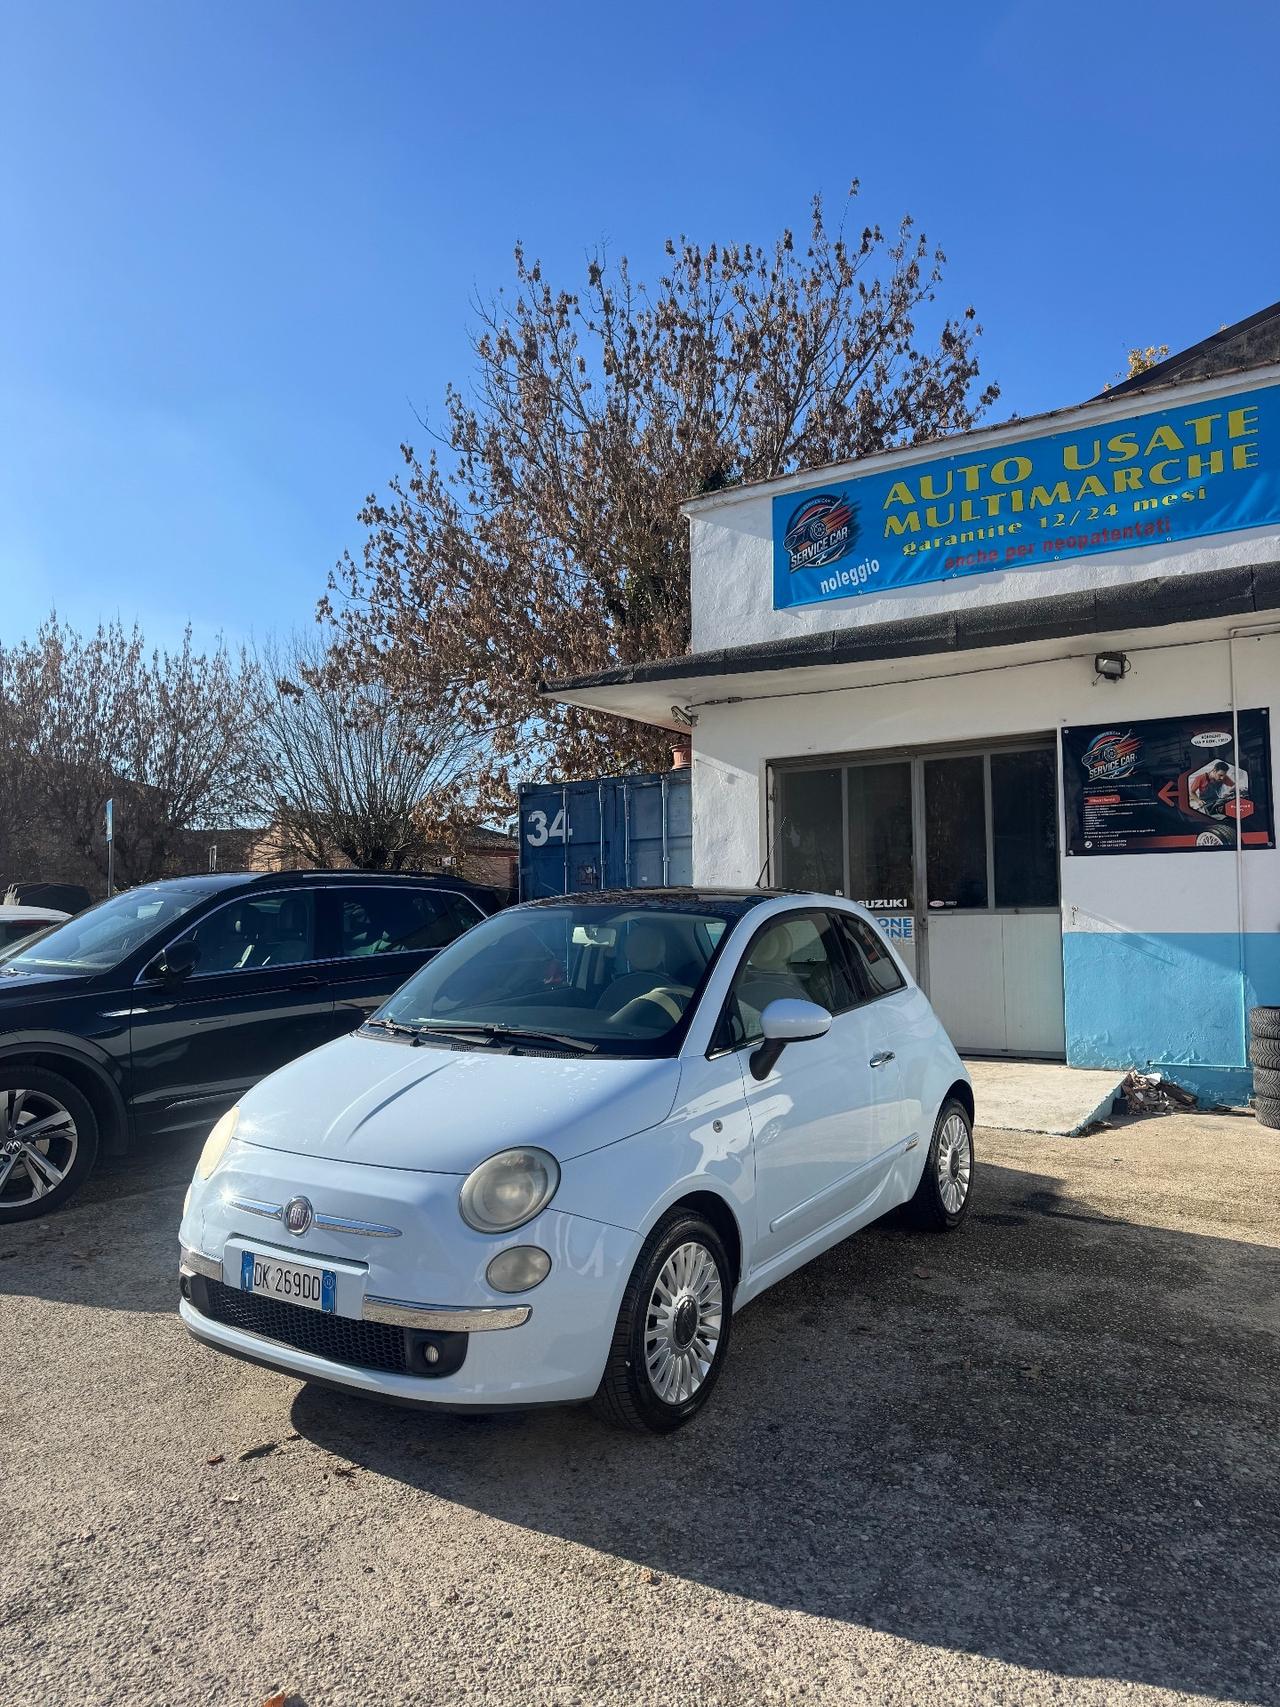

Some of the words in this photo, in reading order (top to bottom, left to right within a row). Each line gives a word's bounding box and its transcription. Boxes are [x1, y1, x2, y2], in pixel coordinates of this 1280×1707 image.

[882, 456, 1033, 510] AUTO
[1063, 406, 1259, 471] USATE
[884, 442, 1259, 538] MULTIMARCHE
[902, 522, 1024, 556] garantite
[1039, 503, 1119, 529] 12/24
[1133, 486, 1207, 512] mesi
[790, 537, 829, 568] SERVICE
[829, 526, 848, 546] CAR
[944, 546, 999, 570] anche
[1005, 543, 1035, 562] per
[1042, 516, 1172, 552] neopatentati
[820, 558, 880, 595] noleggio
[1089, 759, 1120, 779] SERVICE
[1120, 753, 1136, 766] CAR
[526, 809, 574, 847] 34
[289, 1207, 306, 1226] FIAT
[254, 1262, 271, 1290] DK
[274, 1267, 321, 1301] 269DD
